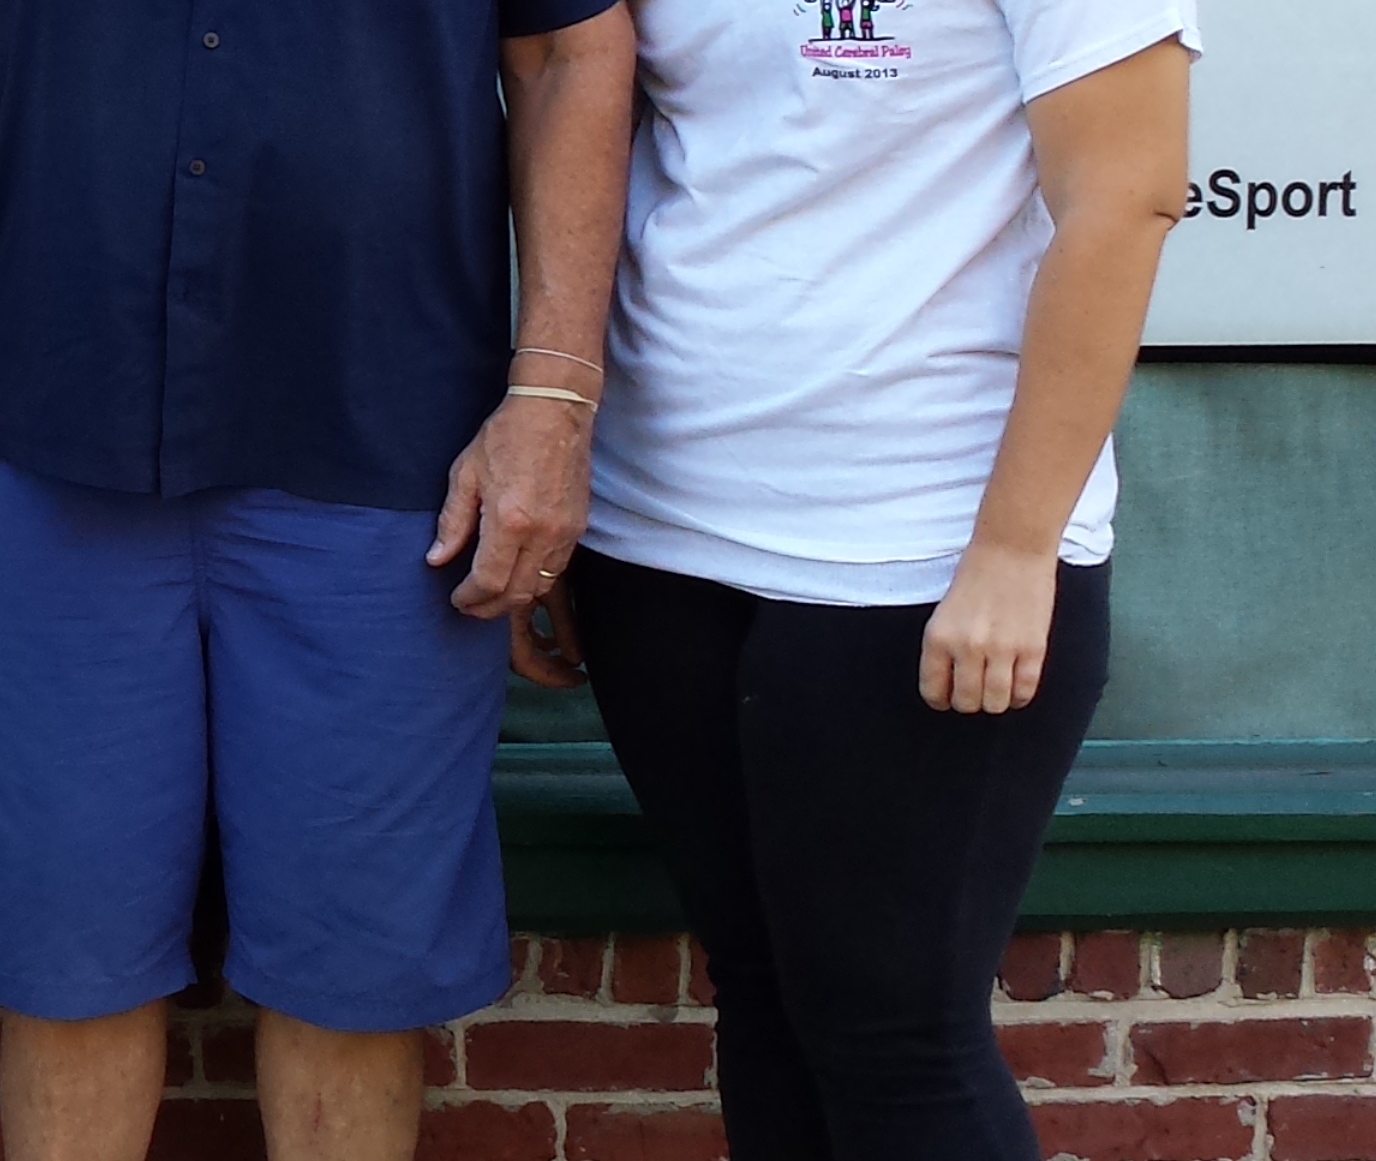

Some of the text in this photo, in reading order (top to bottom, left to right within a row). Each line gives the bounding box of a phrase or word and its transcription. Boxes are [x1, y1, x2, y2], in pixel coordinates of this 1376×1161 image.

[812, 66, 898, 80] August 2013
[1184, 169, 1357, 230] eSport
